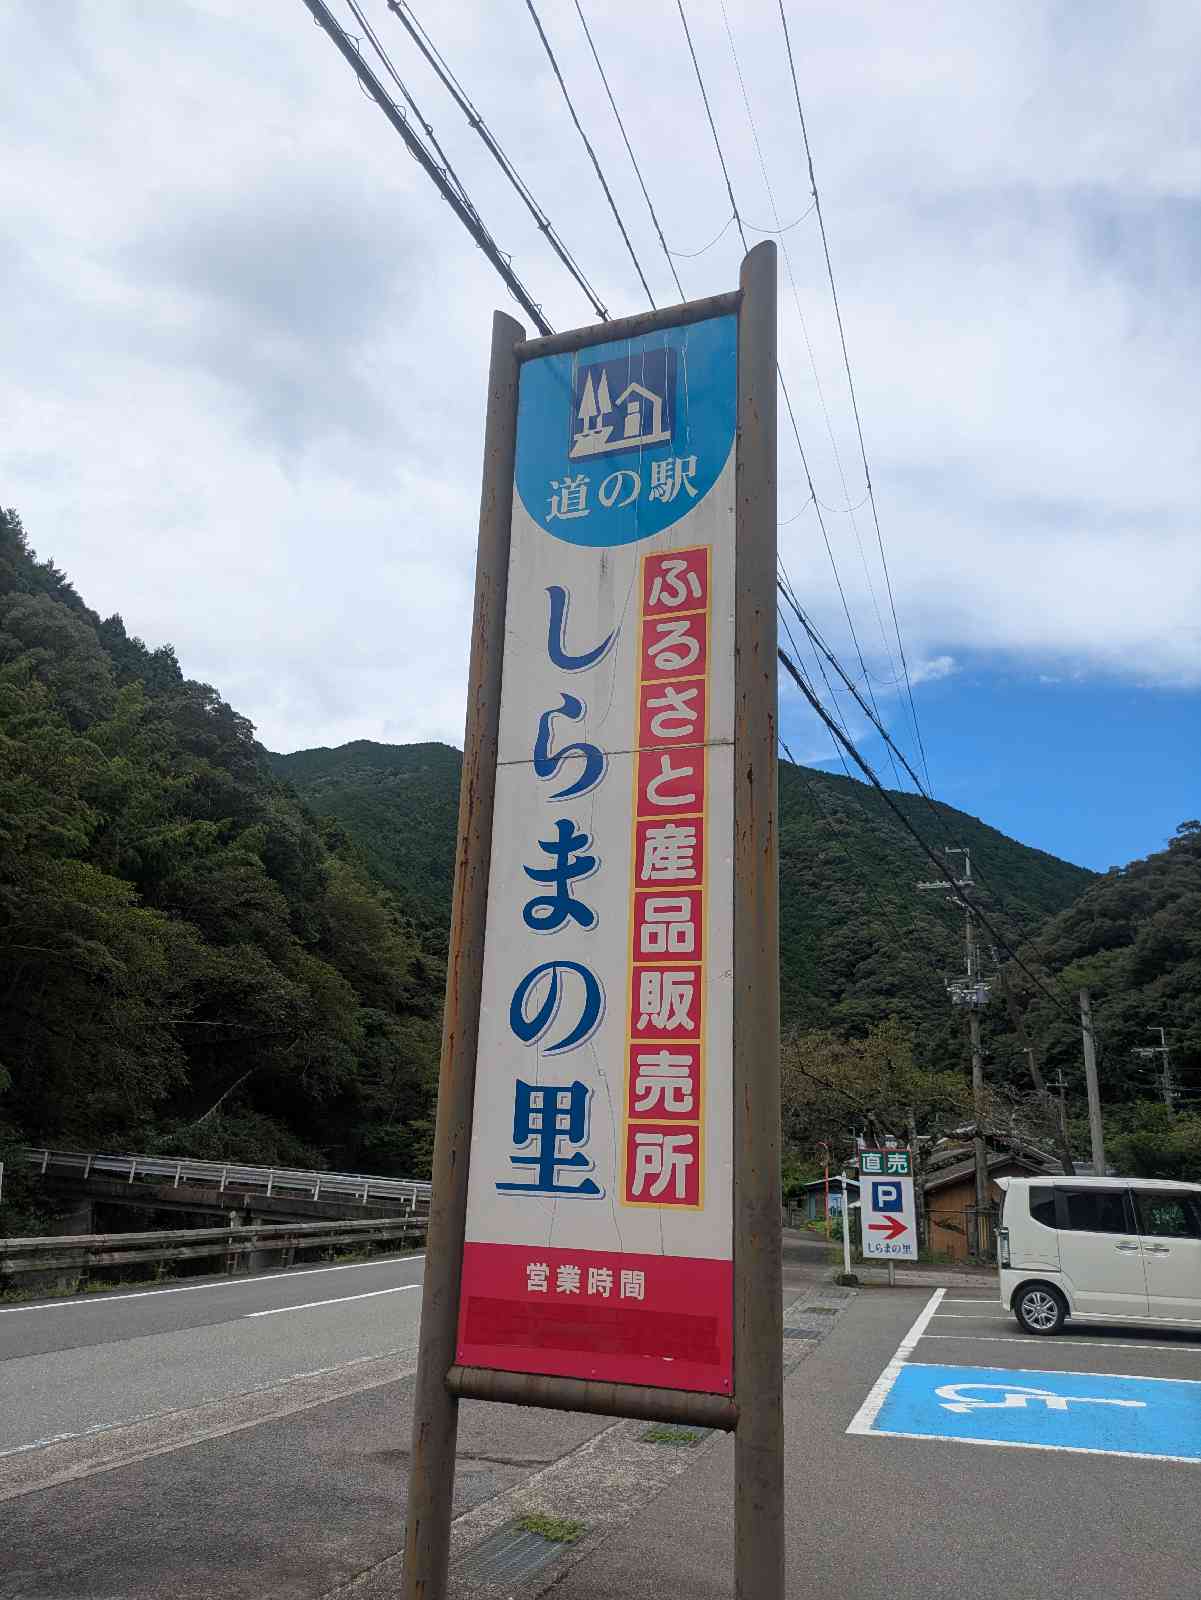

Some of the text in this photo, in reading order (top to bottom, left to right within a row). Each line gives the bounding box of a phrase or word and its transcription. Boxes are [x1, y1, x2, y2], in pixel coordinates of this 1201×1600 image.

[545, 454, 699, 522] 道の駅
[496, 585, 621, 1200] しらまの里
[631, 559, 703, 1201] ふるさと産品販売所
[861, 1153, 908, 1173] 直売
[878, 1185, 897, 1208] P
[868, 1242, 912, 1255] しらまの里
[526, 1262, 646, 1301] 営業時間
